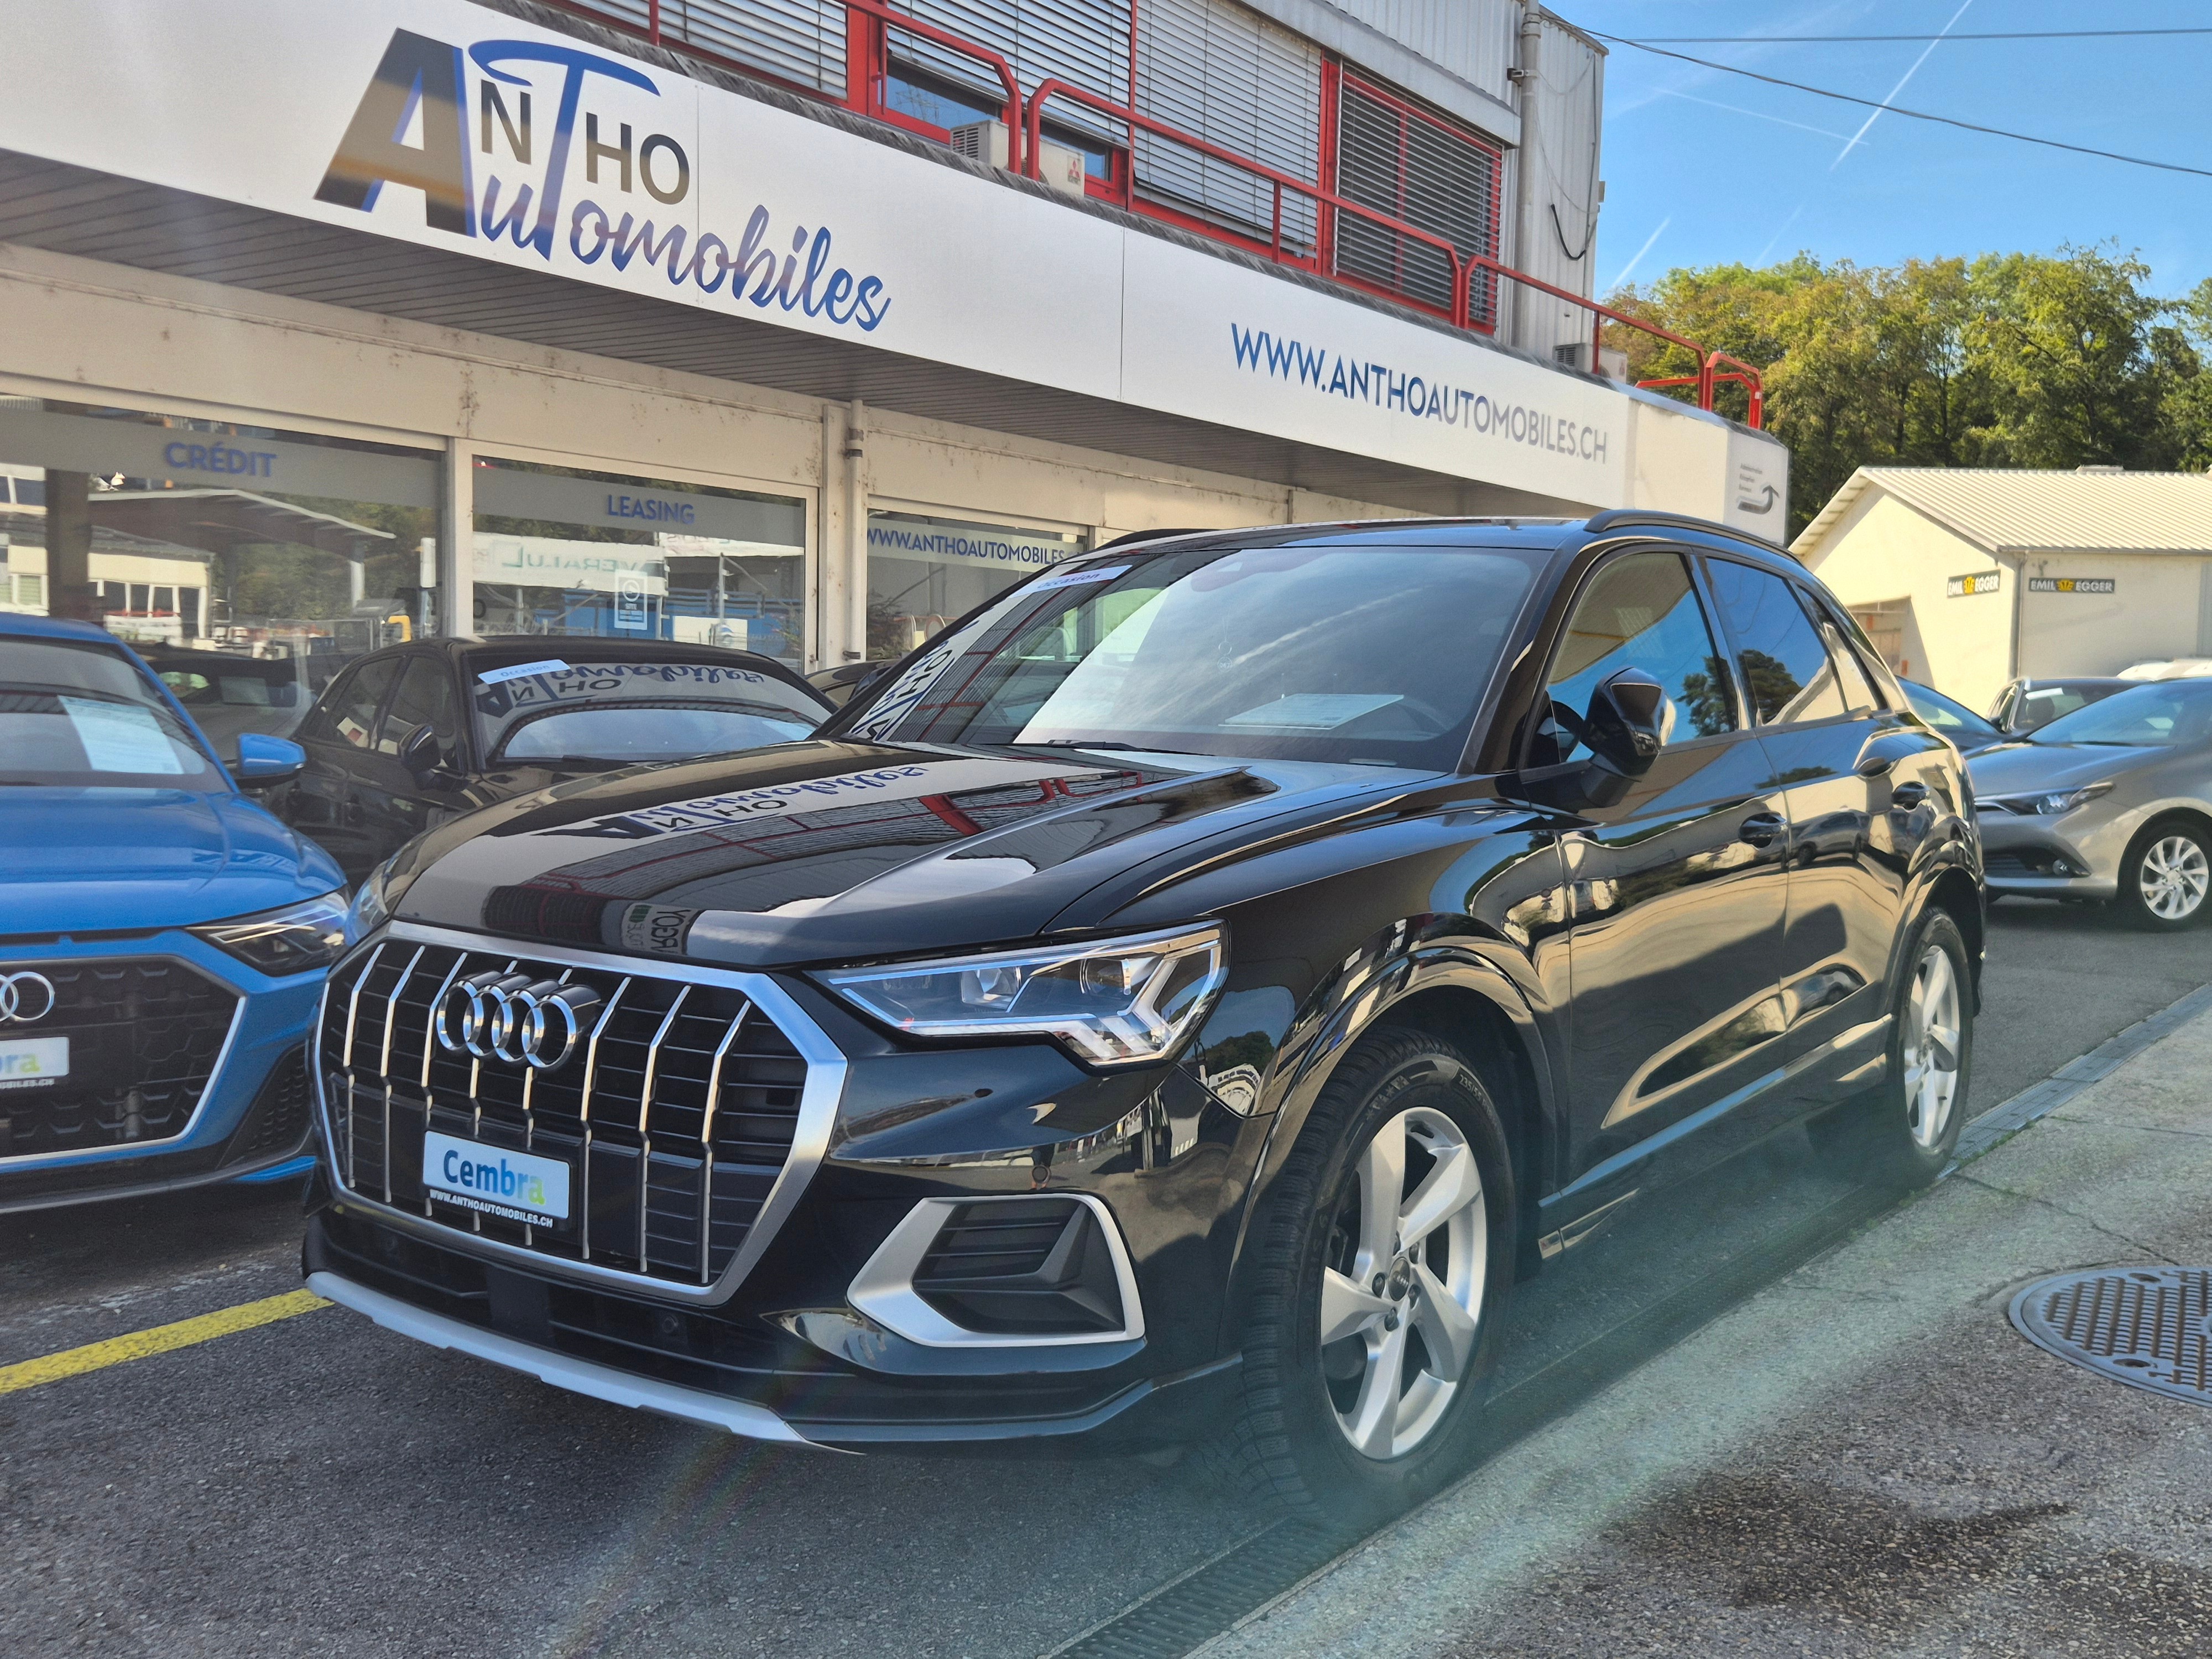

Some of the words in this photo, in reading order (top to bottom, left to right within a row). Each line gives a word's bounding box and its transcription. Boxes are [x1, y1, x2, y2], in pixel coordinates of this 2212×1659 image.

[1230, 322, 1607, 464] WWW.ANTHOAUTOMOBILES.CH
[165, 441, 278, 477] CRÉDIT
[607, 494, 695, 525] LEASING
[1037, 573, 1100, 588] Occasion
[1948, 581, 1963, 596] EMIL
[1975, 575, 1999, 592] EGGER
[2030, 580, 2056, 591] EMIL
[2075, 582, 2112, 592] EGGER
[444, 1149, 547, 1205] Cembra
[429, 1189, 554, 1228] WWW.ANTHOAUTOMOBILES.CH
